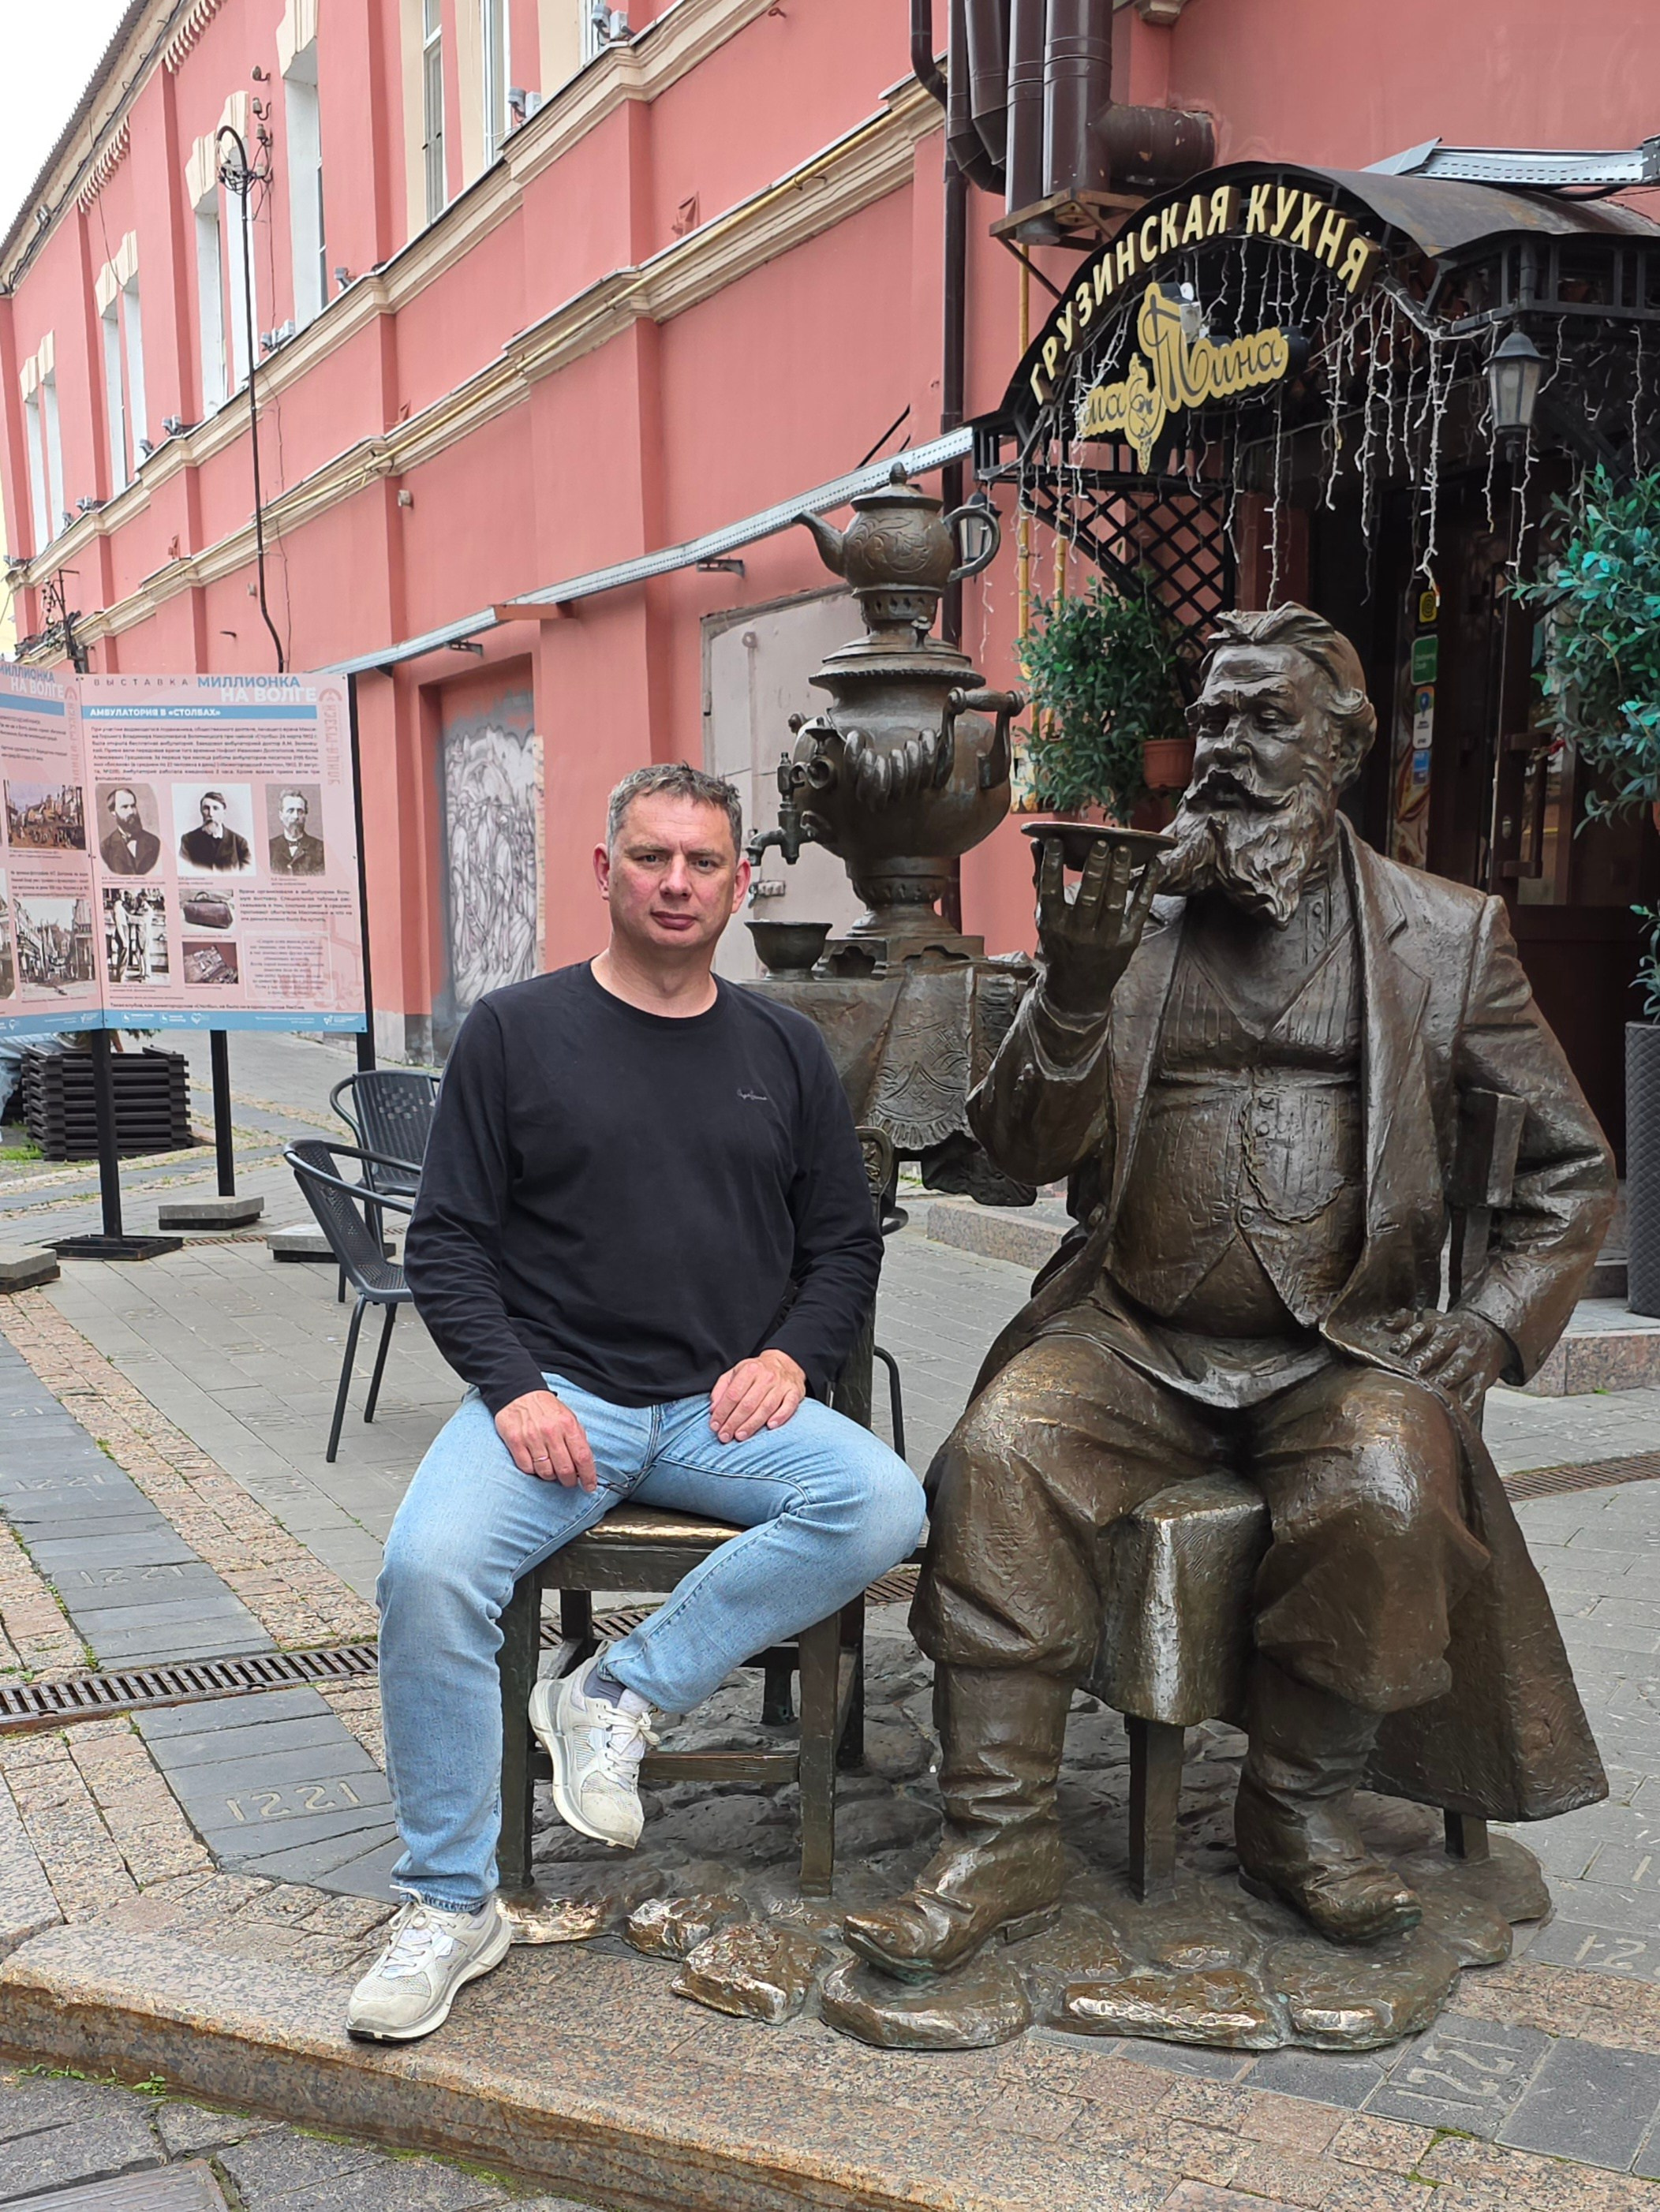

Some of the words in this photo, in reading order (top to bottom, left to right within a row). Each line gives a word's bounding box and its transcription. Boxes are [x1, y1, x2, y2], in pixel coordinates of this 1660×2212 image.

[1029, 185, 1235, 405] ГРУЗИНСКАЯ
[1246, 184, 1370, 293] КУХНЯ
[11, 678, 27, 693] НА
[30, 680, 64, 698] ВОЛГЕ
[94, 678, 189, 687] ВЫСТАВКА
[198, 676, 301, 688] МИЛЛИОНКА
[221, 688, 249, 702] НА
[254, 687, 317, 702] ВОЛГЕ
[90, 708, 158, 717] АМБУЛАТОРИЯ
[168, 708, 221, 717] «СТОЛБАХ»
[226, 1780, 360, 1822] 1221
